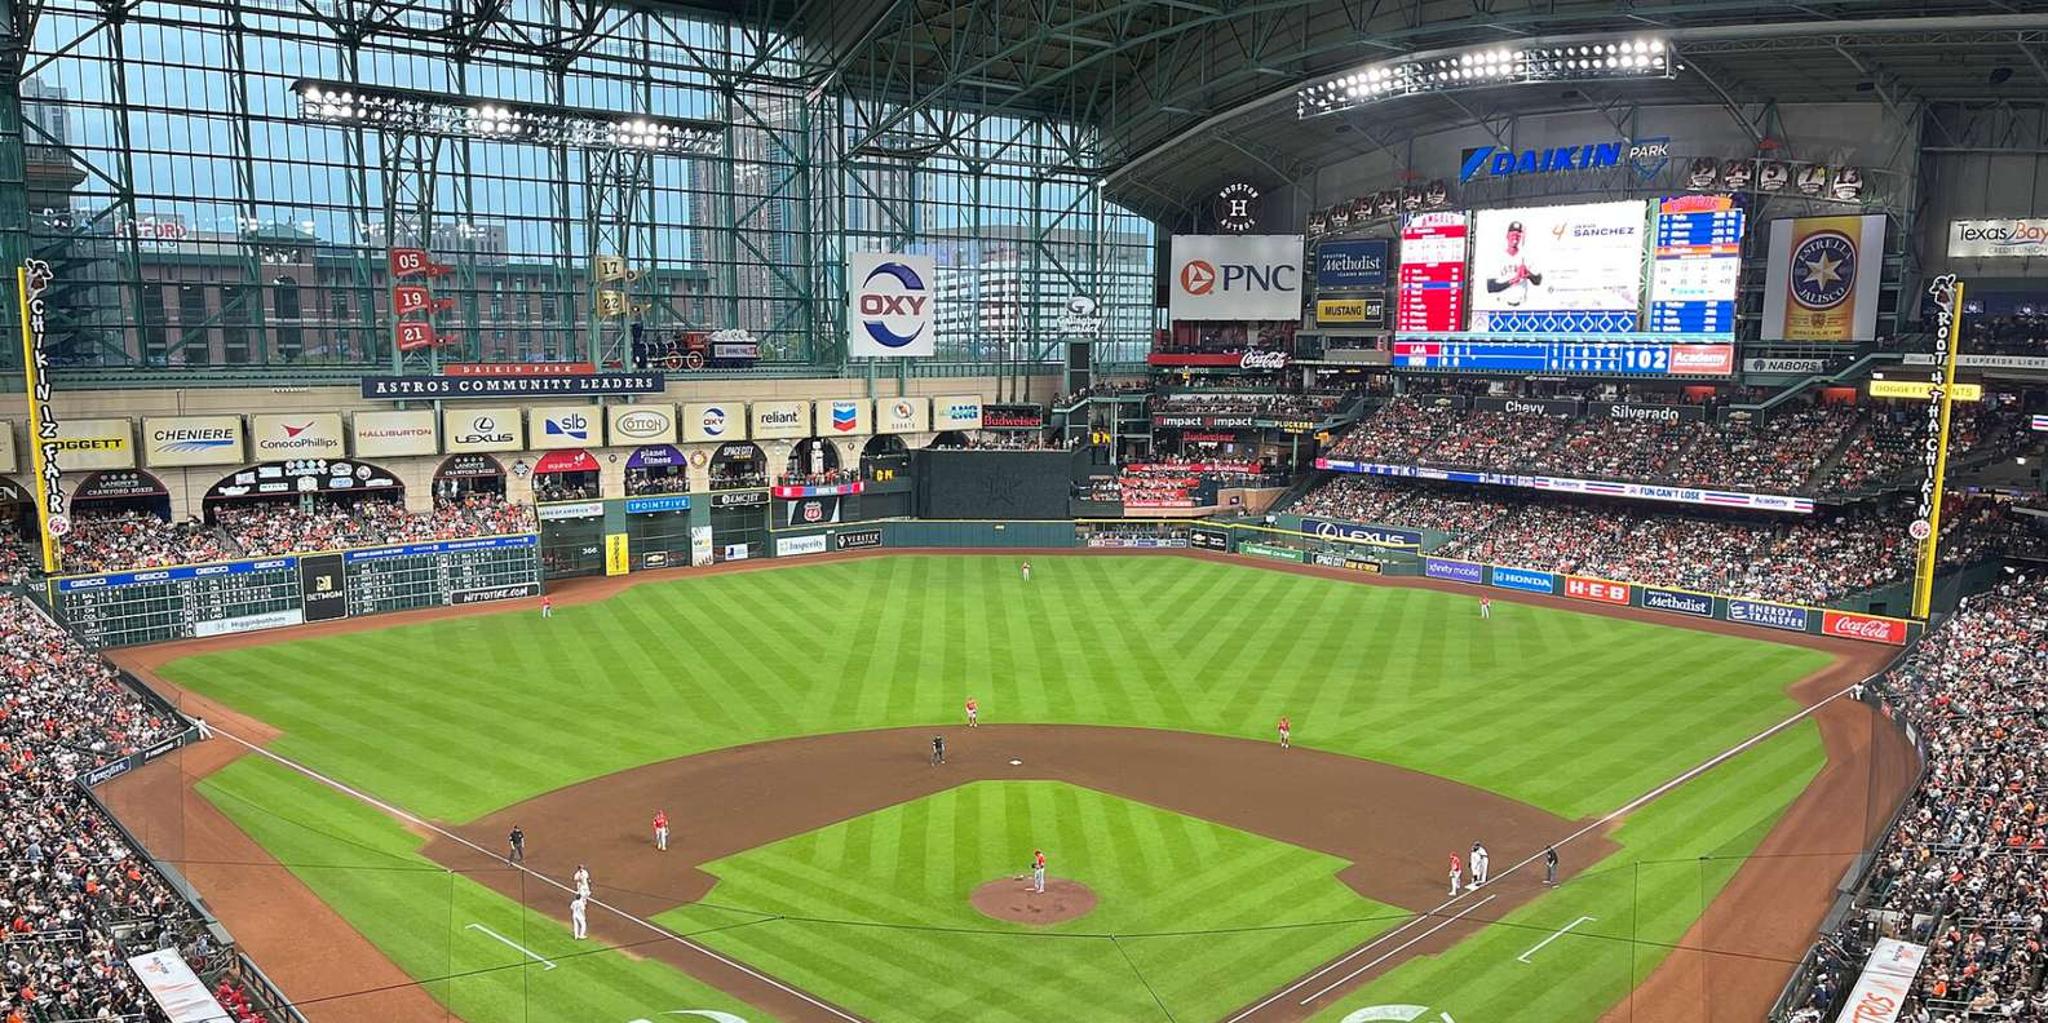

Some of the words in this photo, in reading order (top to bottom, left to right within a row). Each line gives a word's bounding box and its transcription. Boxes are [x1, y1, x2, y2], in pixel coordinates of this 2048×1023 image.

[1491, 142, 1622, 175] DAIKIN
[1630, 144, 1668, 158] PARK
[1219, 183, 1259, 198] HOUSTON
[1230, 200, 1247, 216] H
[1221, 219, 1255, 231] ASTROS
[1574, 227, 1635, 237] SANCHEZ
[1958, 224, 2007, 240] Texas
[1799, 239, 1852, 261] ESTRELLA
[399, 254, 419, 269] 05
[1323, 255, 1380, 271] Methodist
[602, 262, 617, 275] 17
[1220, 265, 1296, 291] PNC
[403, 292, 422, 306] 19
[1799, 287, 1845, 302] JALISCO
[603, 298, 618, 311] 22
[860, 294, 927, 316] OXY
[1325, 306, 1361, 315] MUSTANG
[1366, 305, 1380, 316] CAT
[404, 327, 423, 341] 21
[1410, 345, 1426, 354] LAA
[1240, 352, 1288, 368] Coca-Cola
[1674, 352, 1727, 367] Academy
[1768, 361, 1817, 371] NABORS
[1966, 357, 2013, 366] SUPERIOR
[2017, 359, 2046, 367] LIGHT
[376, 381, 450, 394] ASTROS
[459, 379, 573, 392] COMMUNITY
[580, 377, 653, 390] LEADERS
[1505, 401, 1545, 416] Chevy
[1610, 406, 1679, 421] Silverado
[562, 412, 587, 430] slb
[623, 417, 661, 431] COTTON
[704, 418, 724, 426] OXY
[761, 412, 797, 423] reliant
[984, 416, 1041, 427] Budweiser
[1163, 417, 1202, 427] impact
[1214, 417, 1252, 427] impact
[154, 429, 234, 441] CHENIERE
[358, 429, 432, 438] HALLIBURTON
[455, 433, 514, 445] LEXUS
[260, 439, 338, 450] ConocoPhillips
[641, 449, 667, 459] planet
[87, 488, 129, 496] CRAWFORD
[1640, 487, 1655, 498] FUN
[1656, 489, 1679, 500] CAN'T
[1680, 490, 1701, 501] LOSE
[631, 500, 687, 511] 1POINTFIVE
[1339, 529, 1406, 545] LEXUS
[196, 565, 229, 575] GEICO
[254, 560, 286, 569] GEICO
[1429, 563, 1452, 574] xfinity
[1453, 567, 1479, 577] mobile
[135, 571, 169, 581] GEICO
[1505, 574, 1551, 588] HONDA
[70, 578, 107, 588] GEICO
[306, 590, 343, 602] BETMGM
[1650, 596, 1706, 613] Methodist
[1749, 604, 1793, 617] ENERGY
[1750, 612, 1803, 627] TRANSFER
[1836, 617, 1889, 639] Coca-Cola
